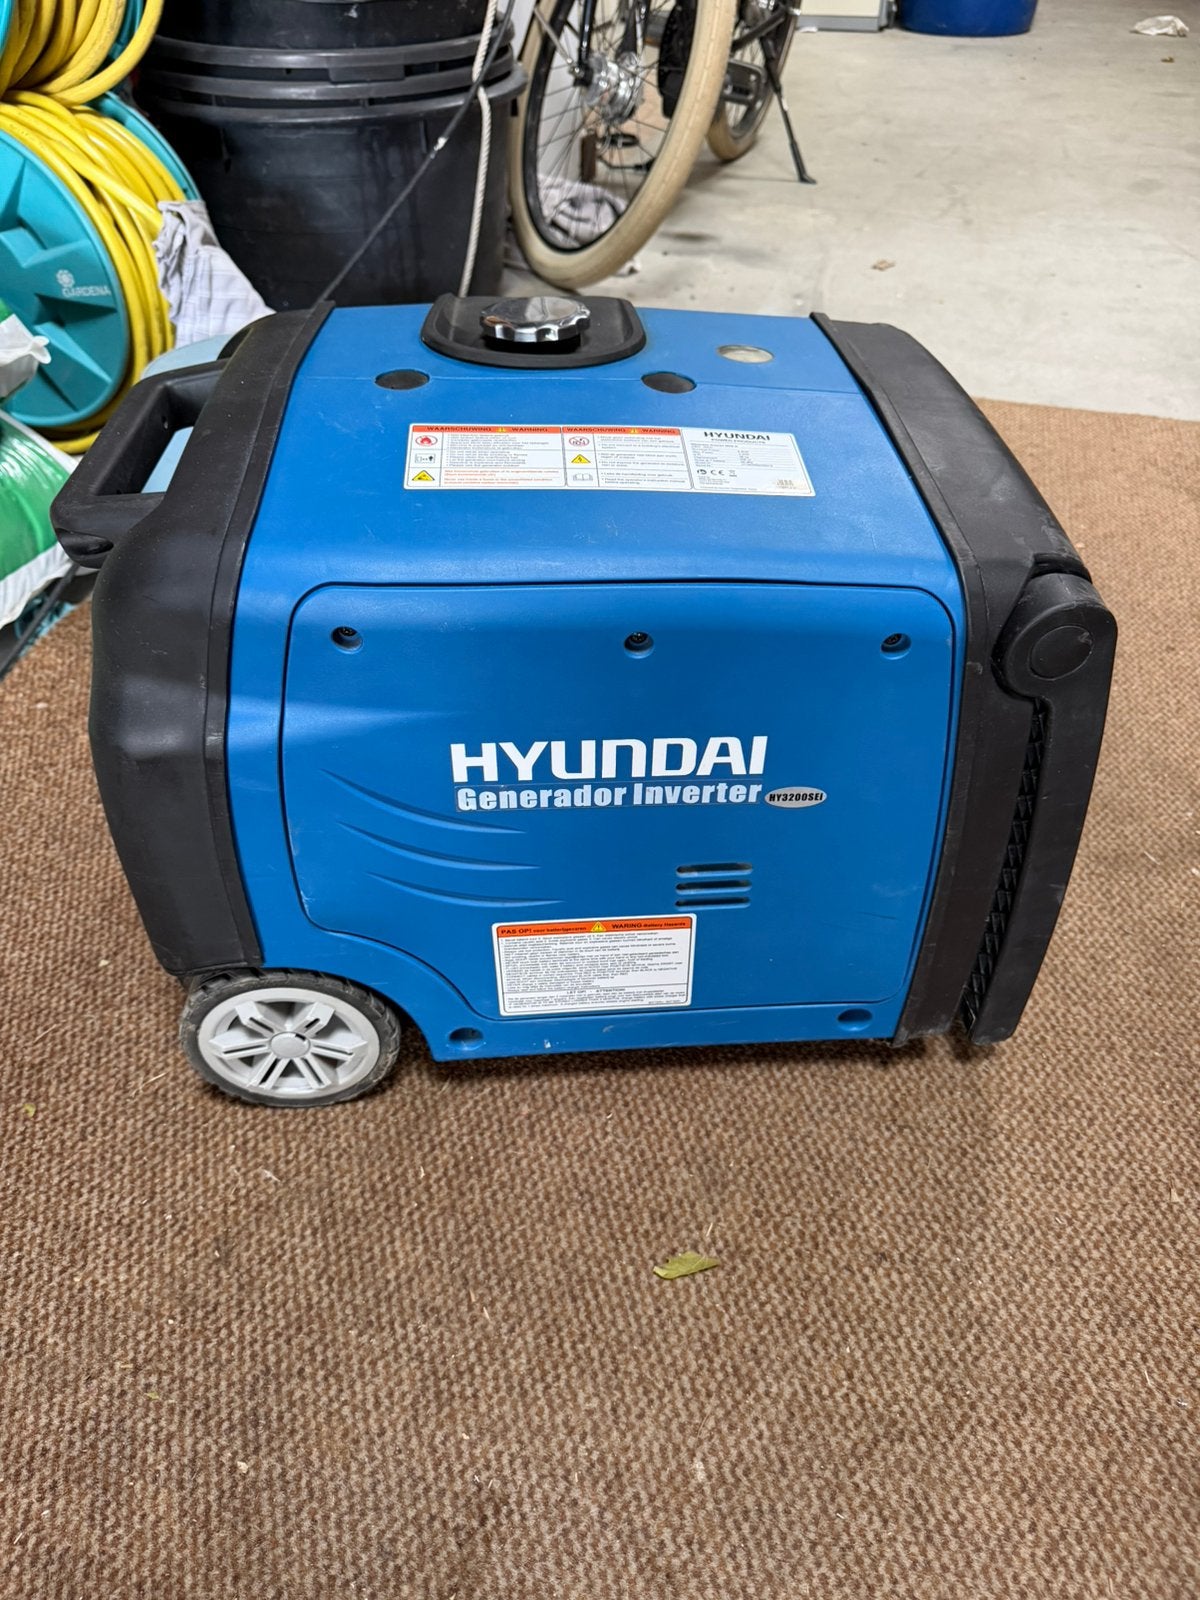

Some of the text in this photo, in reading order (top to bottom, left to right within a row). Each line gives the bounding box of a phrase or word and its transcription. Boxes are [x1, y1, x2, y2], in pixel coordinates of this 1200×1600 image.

[62, 286, 112, 298] GARDENA
[703, 431, 771, 441] HYUNDAI
[450, 736, 768, 783] HYUNDAI
[456, 782, 824, 811] Generador Inverter HY3200SEI
